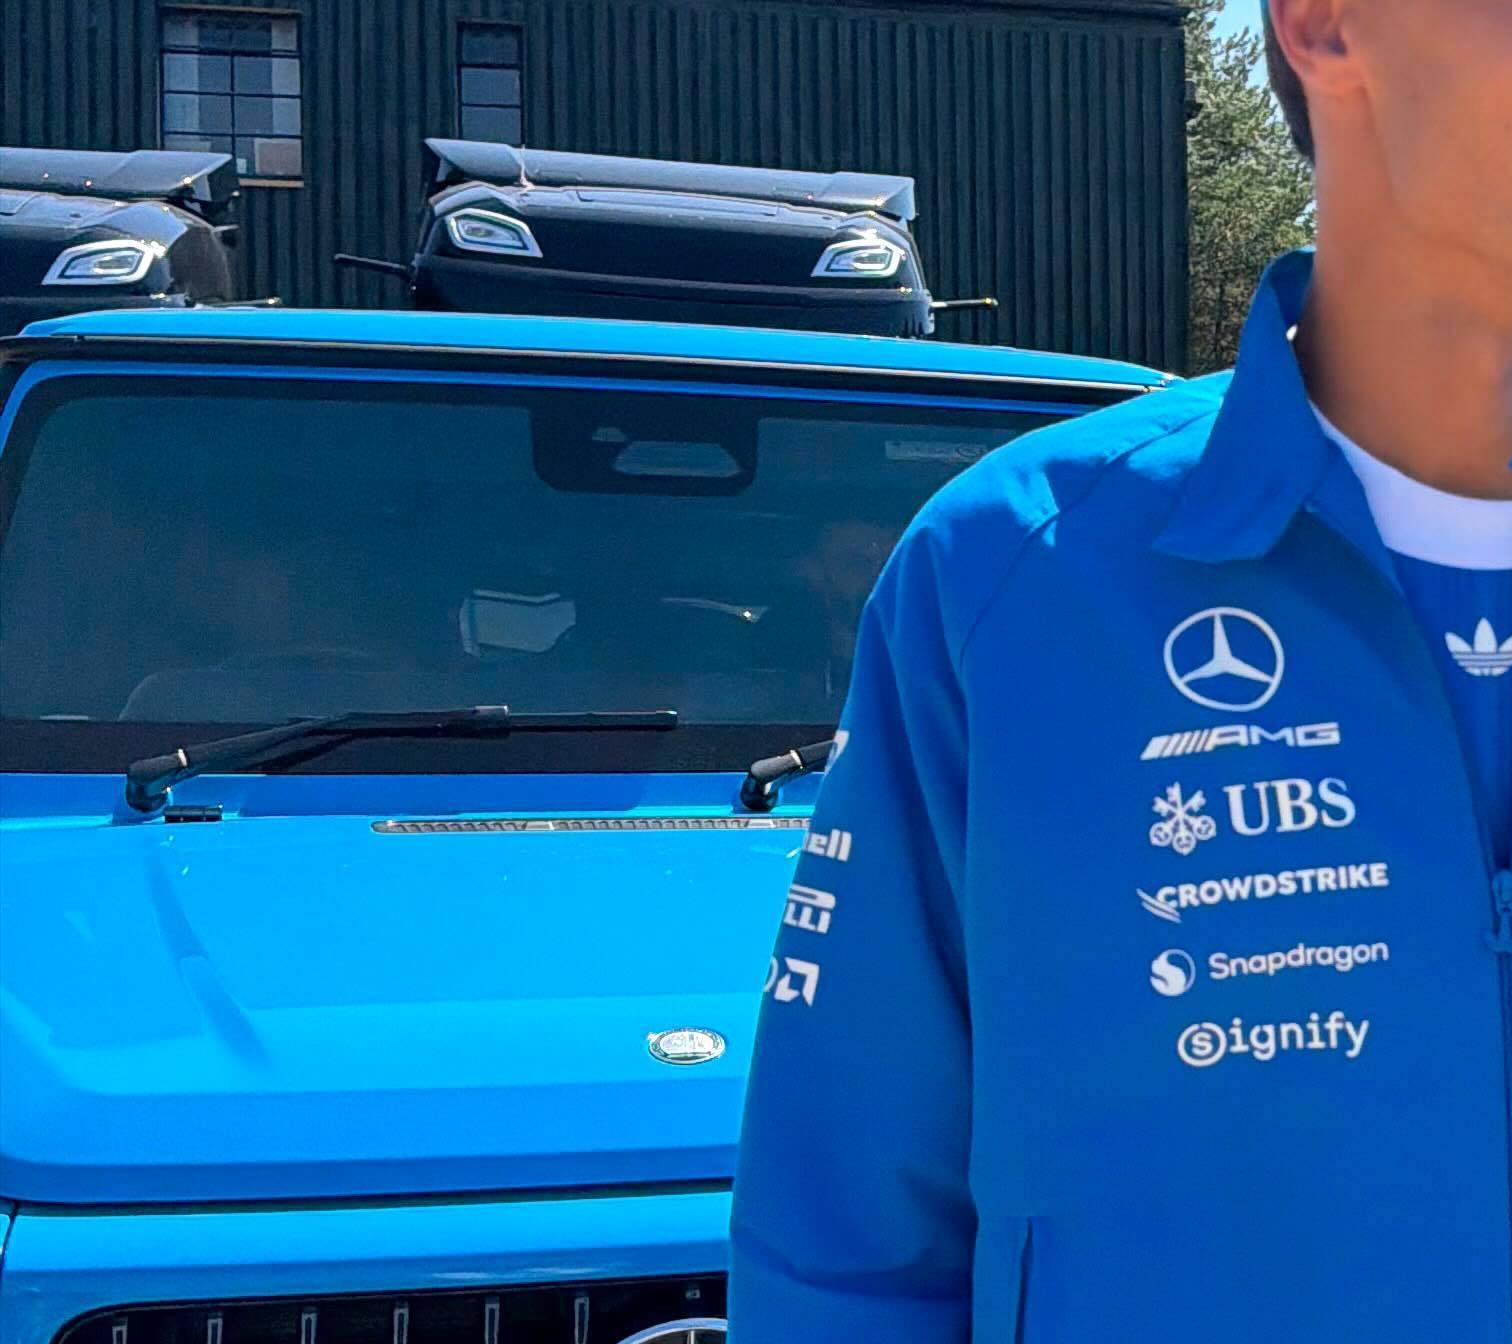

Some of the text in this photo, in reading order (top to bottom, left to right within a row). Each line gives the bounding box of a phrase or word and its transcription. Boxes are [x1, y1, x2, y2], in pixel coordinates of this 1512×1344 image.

[1207, 722, 1340, 751] AMG
[1223, 777, 1357, 836] UBS
[1156, 862, 1390, 909] CROWDSTRIKE
[1208, 941, 1390, 980] Snapdragon
